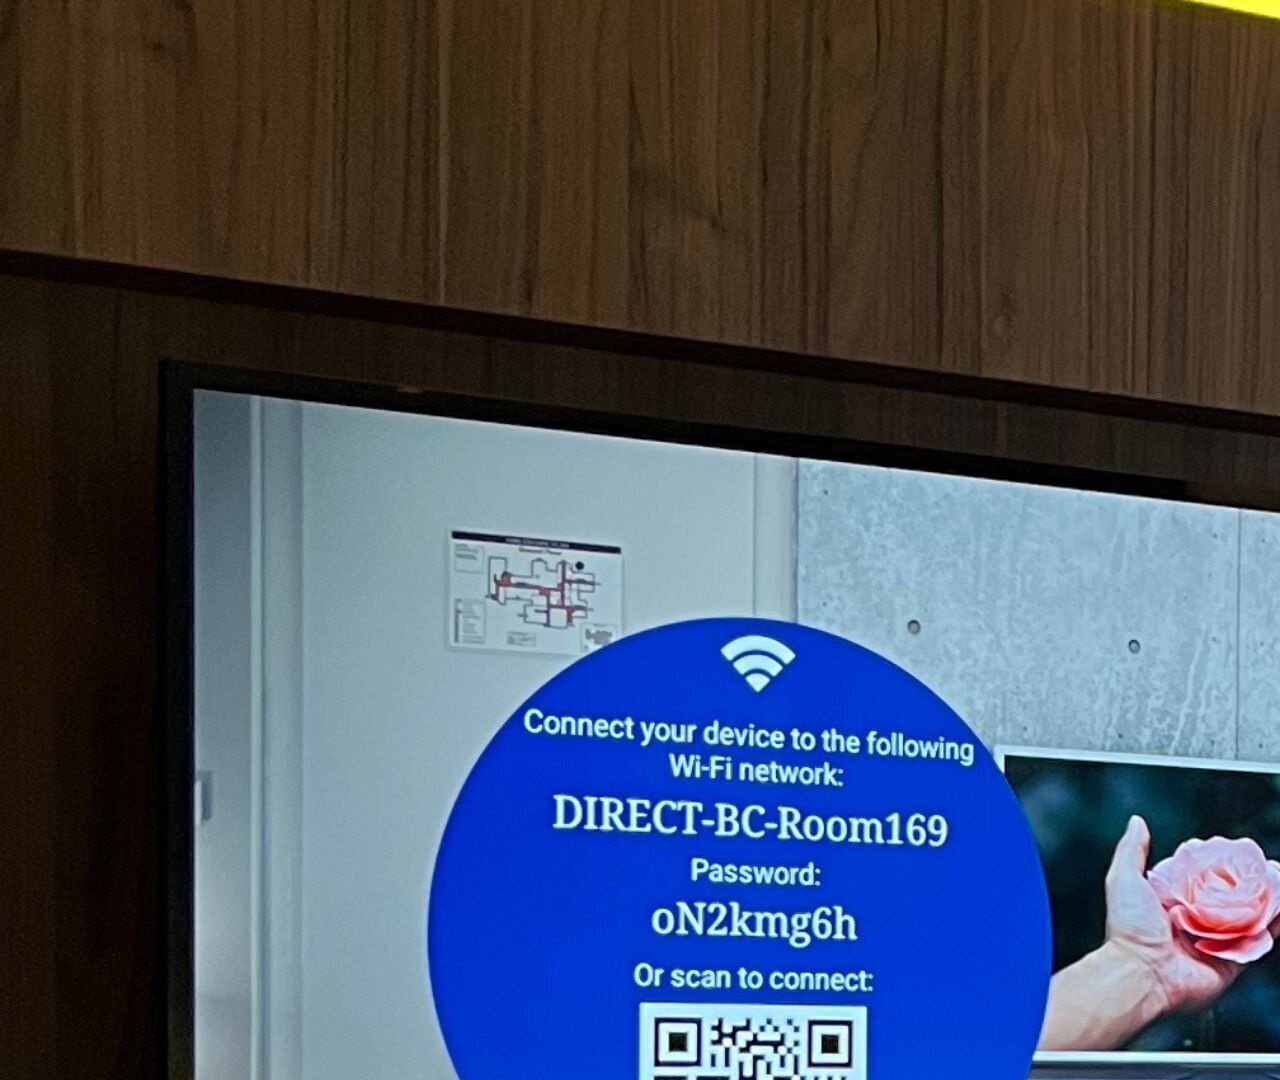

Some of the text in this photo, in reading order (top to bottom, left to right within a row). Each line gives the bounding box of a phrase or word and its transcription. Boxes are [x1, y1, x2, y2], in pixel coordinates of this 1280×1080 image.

[524, 708, 975, 767] Connect your device to the following
[668, 753, 845, 787] Wi-Fi network:
[551, 793, 949, 848] DIRECT-BC-Room169
[691, 857, 822, 887] Password:
[651, 901, 859, 949] oN2kmg6h
[633, 962, 874, 992] Or scan to connect:
